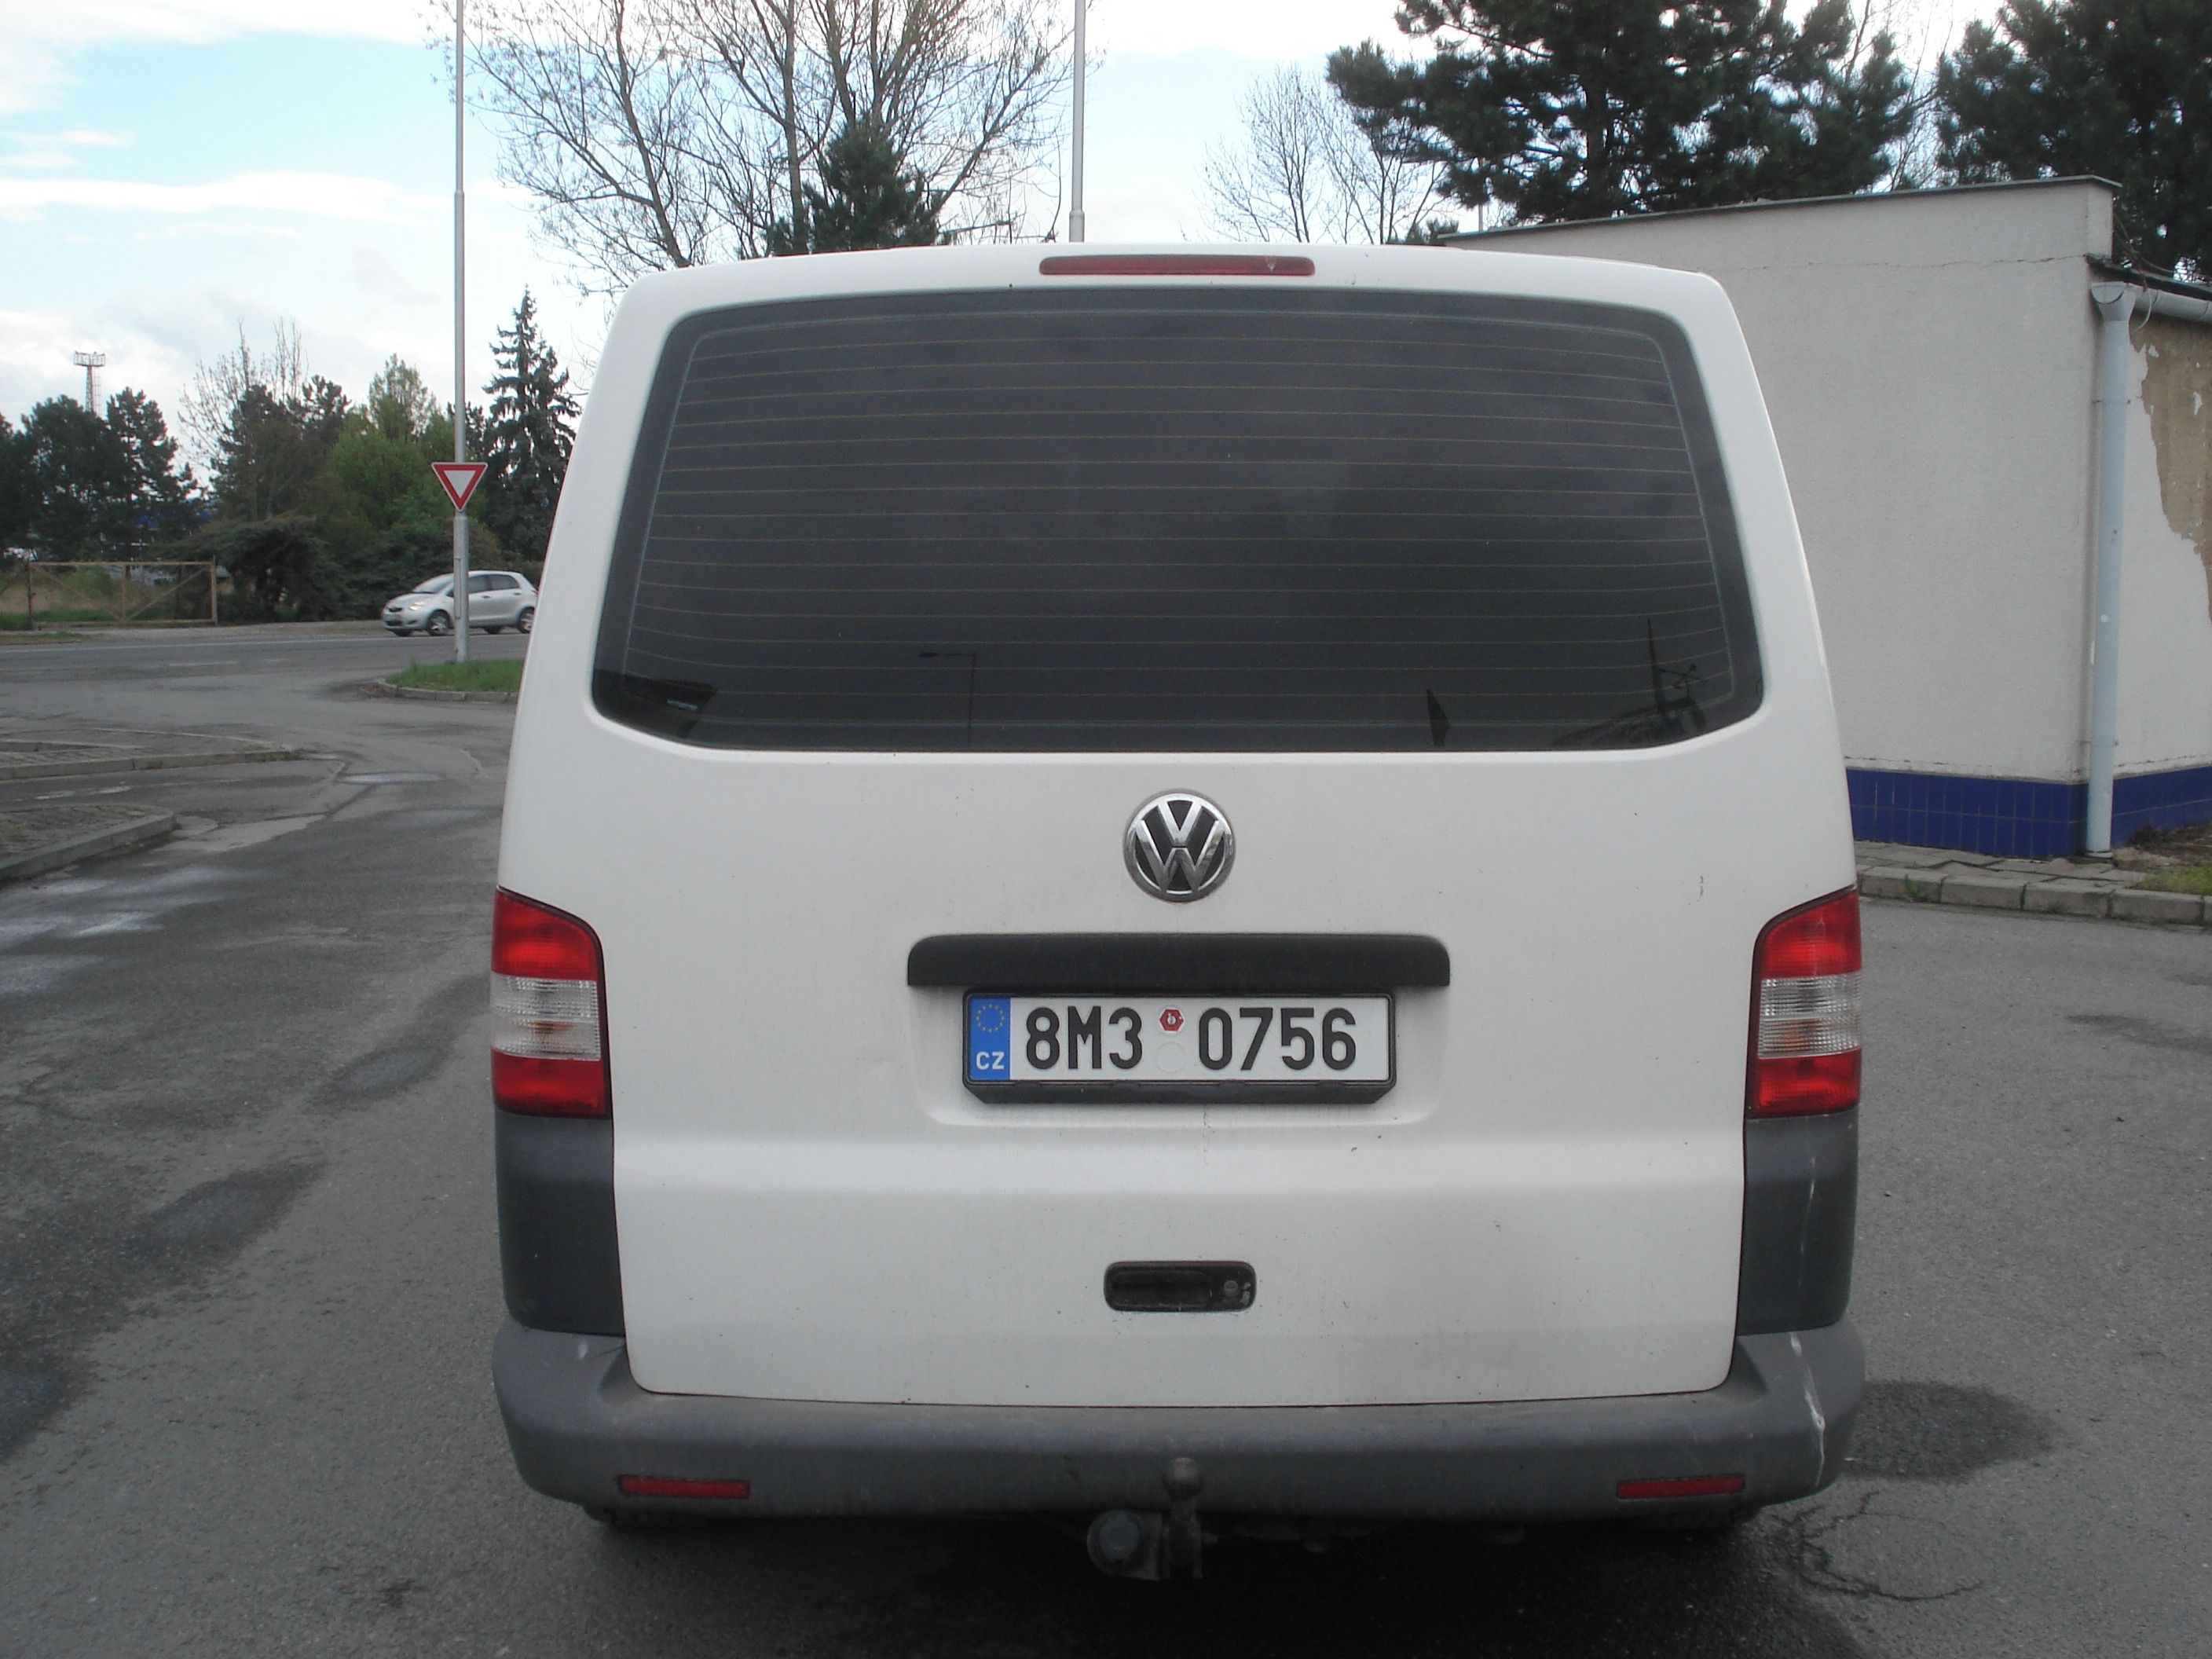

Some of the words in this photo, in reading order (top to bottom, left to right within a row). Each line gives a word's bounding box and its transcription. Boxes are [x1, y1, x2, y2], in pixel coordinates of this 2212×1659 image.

[1129, 793, 1231, 899] VW
[976, 1051, 1005, 1070] CZ
[1026, 1005, 1143, 1070] 8M3
[1199, 1007, 1357, 1071] 0756
